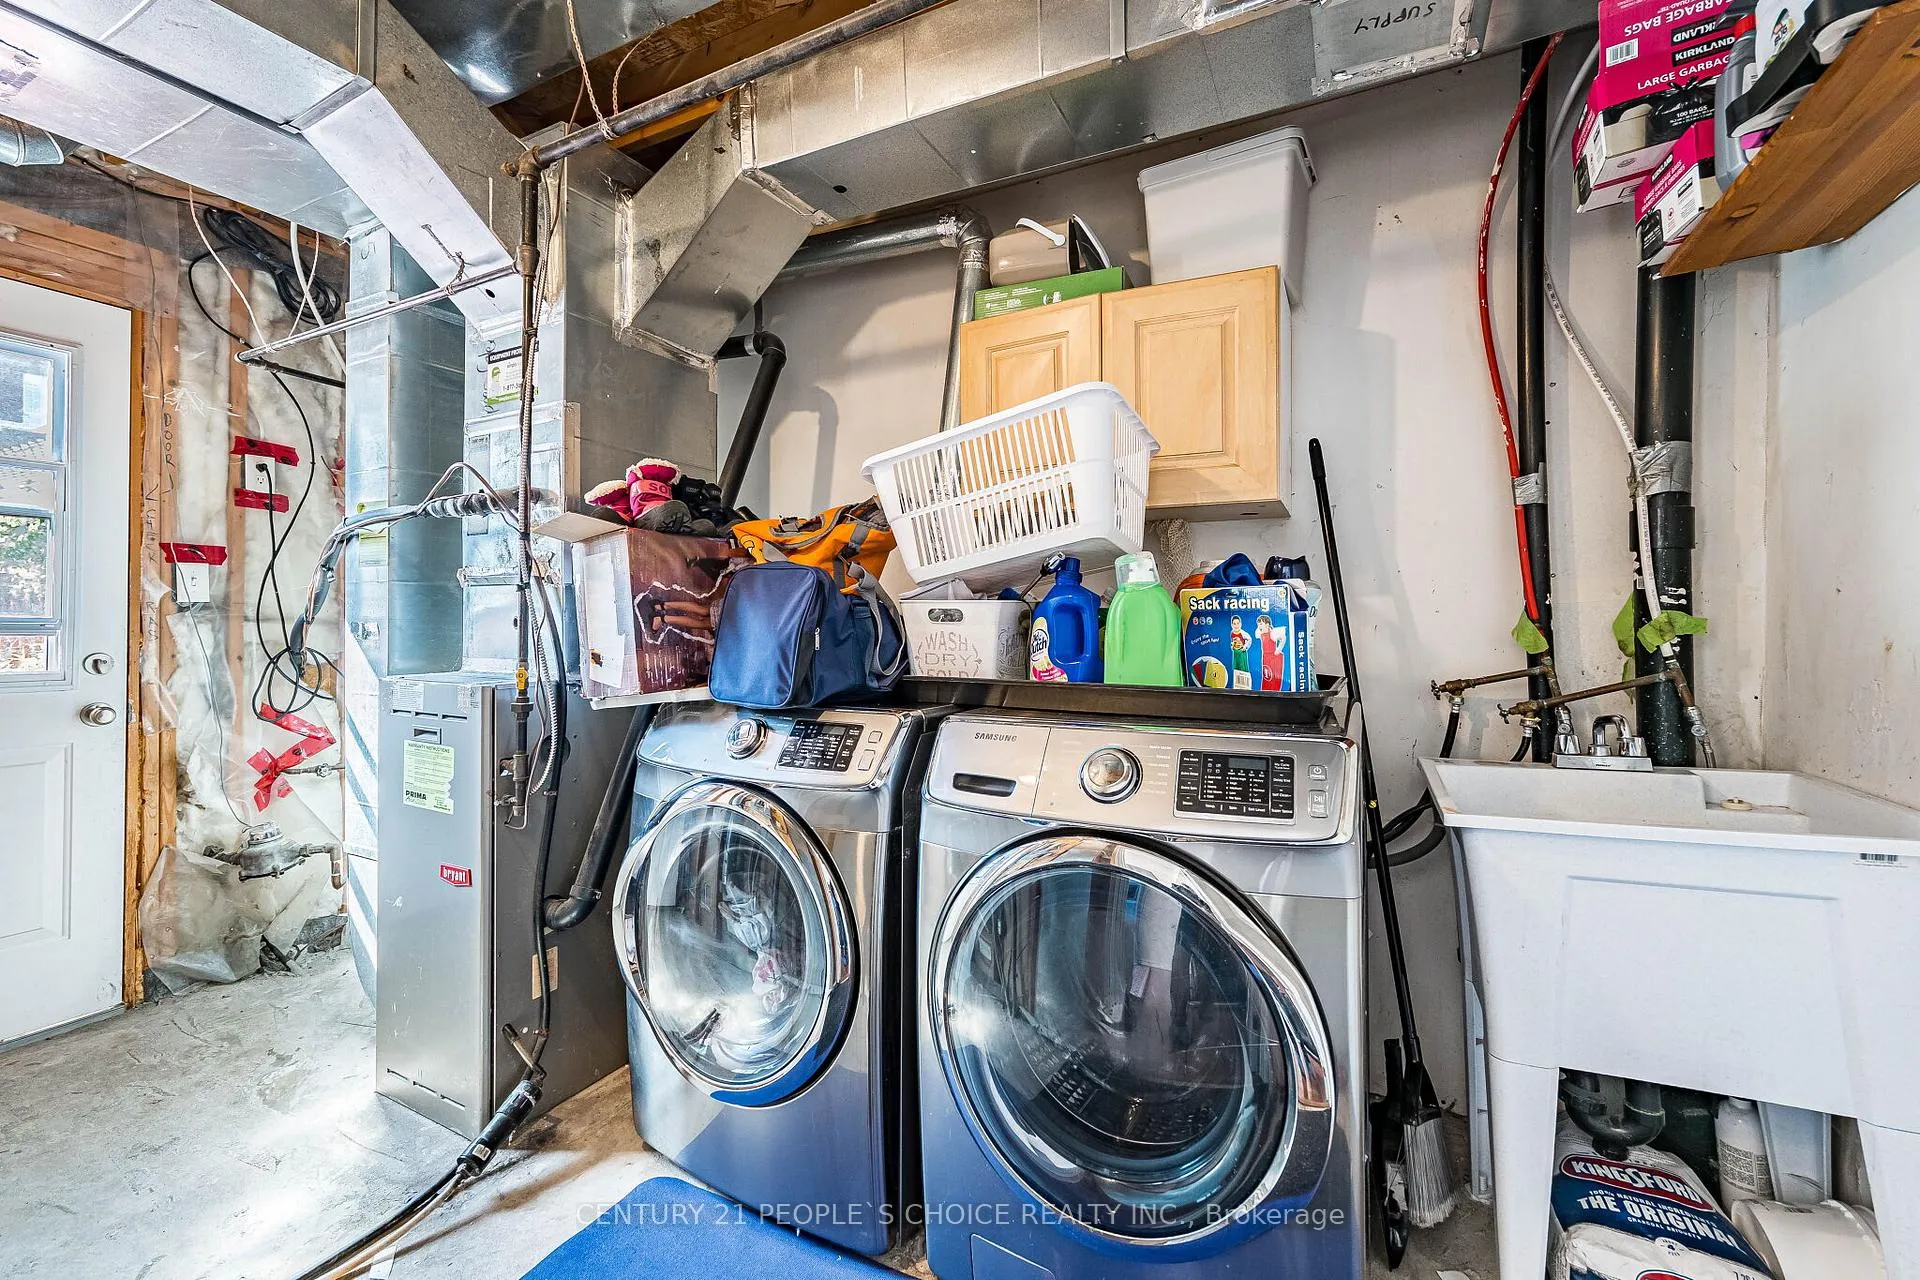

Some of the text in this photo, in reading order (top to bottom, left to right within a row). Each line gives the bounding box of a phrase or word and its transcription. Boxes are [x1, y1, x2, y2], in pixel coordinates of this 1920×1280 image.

[1354, 2, 1436, 34] SUPPLY
[1624, 18, 1661, 36] BAGS
[1675, 36, 1736, 61] KIRKLAND
[1637, 72, 1676, 90] LARGE
[1689, 105, 1708, 116] BAGS
[649, 482, 671, 496] SO
[1189, 596, 1270, 612] Sack racing
[924, 630, 969, 652] WASH
[925, 653, 972, 667] DRY
[1298, 632, 1308, 692] Sack racin
[974, 732, 1017, 742] SAMSUNG
[405, 789, 427, 801] PRIMA
[443, 866, 465, 883] bryant
[1570, 1160, 1703, 1204] KINGSFORD
[1616, 1193, 1656, 1208] NATURAL
[1577, 1194, 1620, 1213] THE
[1626, 1199, 1745, 1254] ORIGINAL
[1627, 1216, 1665, 1229] CHARCOAL
